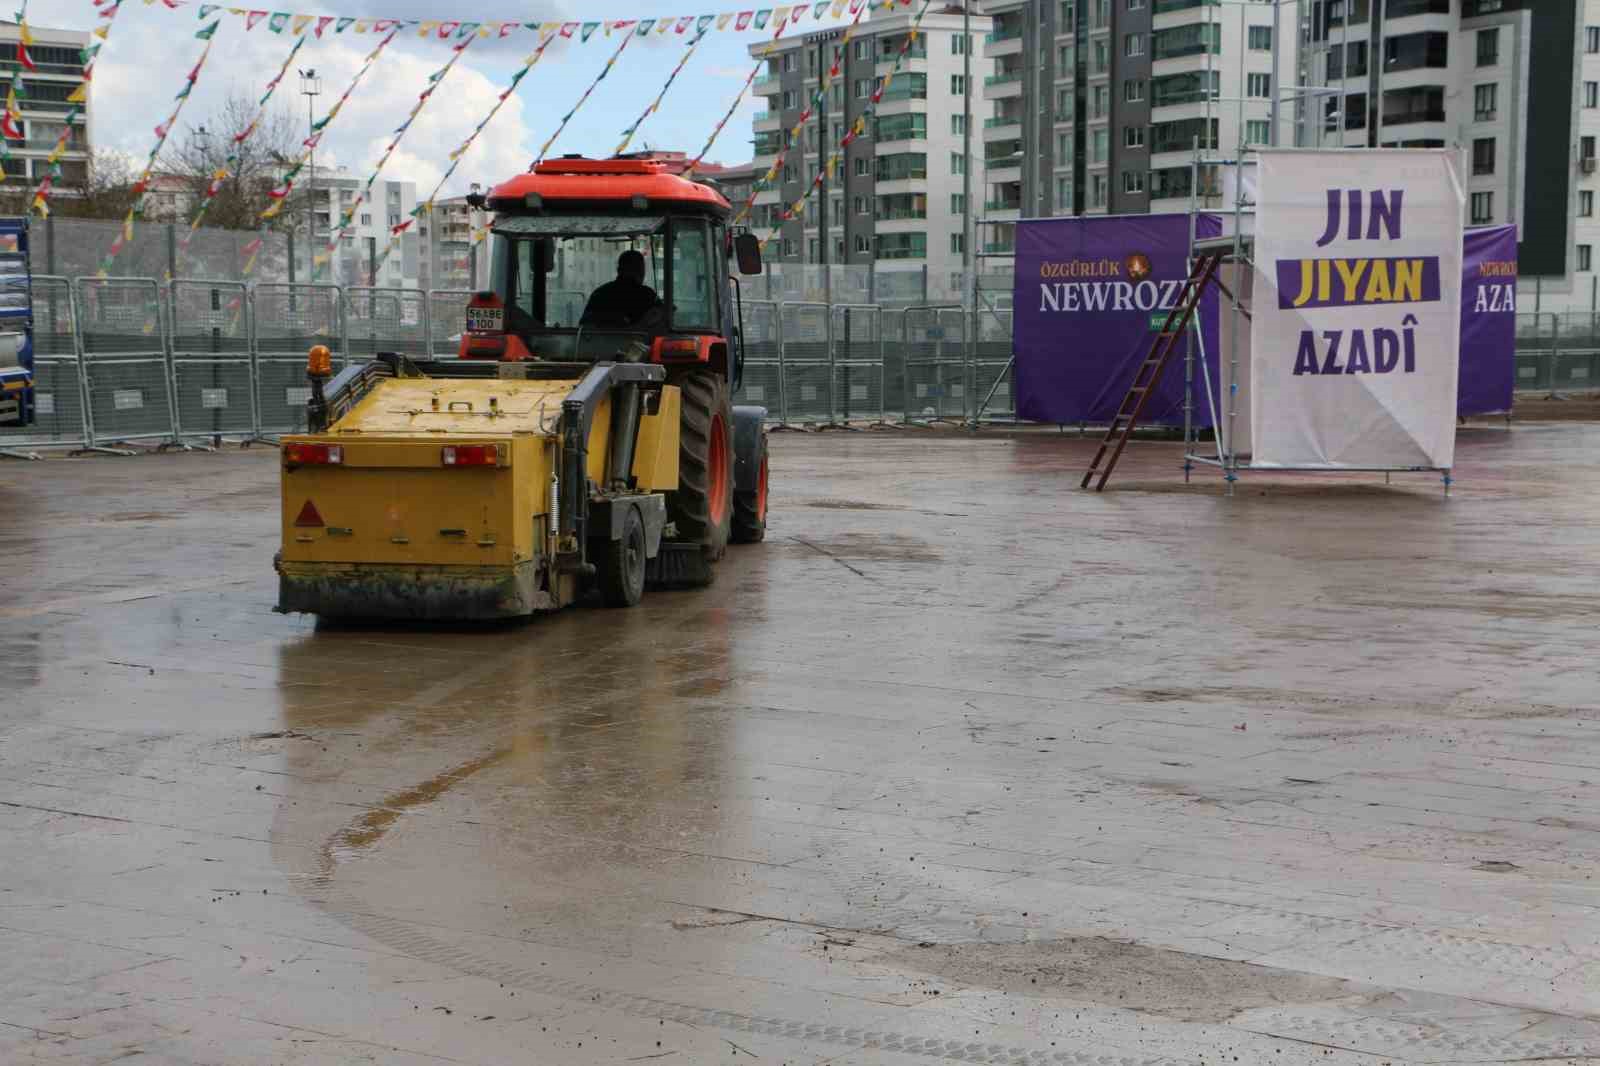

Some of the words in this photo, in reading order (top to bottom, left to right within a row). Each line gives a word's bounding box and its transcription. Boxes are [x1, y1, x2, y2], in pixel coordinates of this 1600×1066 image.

[1316, 189, 1404, 247] JIN
[1040, 259, 1120, 278] ÖZGÜRLÜK
[1293, 259, 1425, 306] JIYAN
[1474, 284, 1514, 312] AZA
[1292, 313, 1419, 376] AZADÎ
